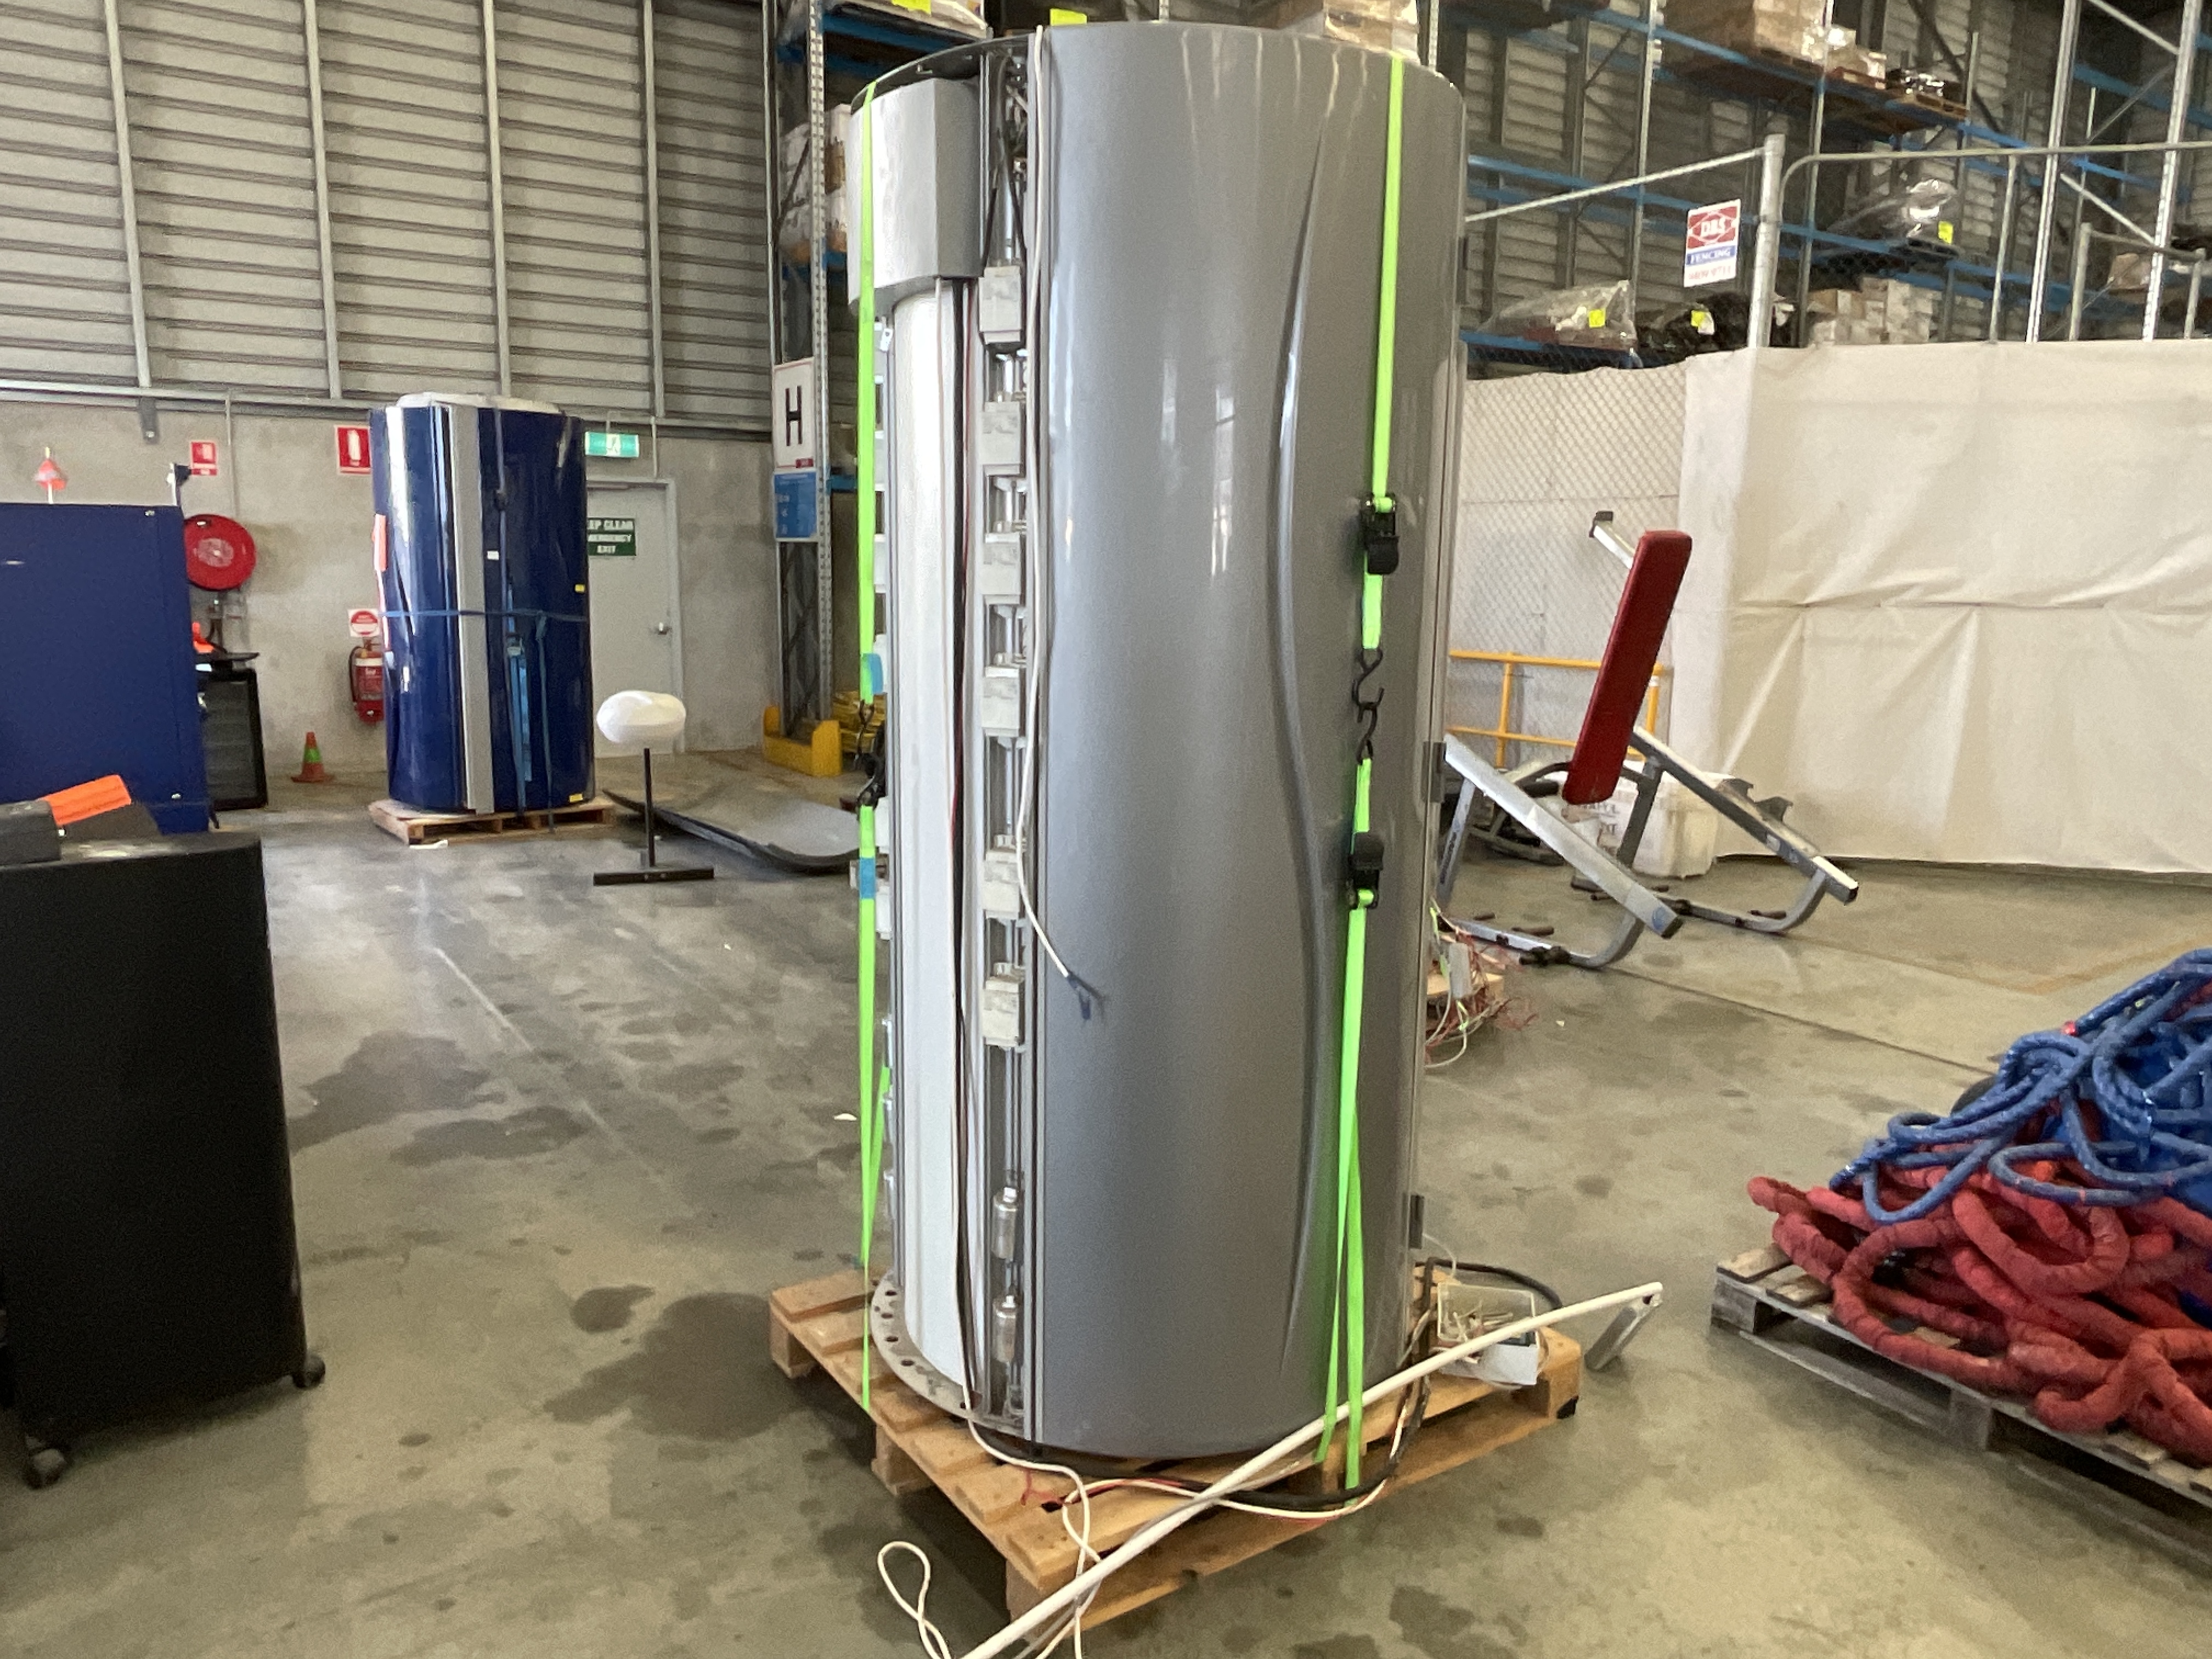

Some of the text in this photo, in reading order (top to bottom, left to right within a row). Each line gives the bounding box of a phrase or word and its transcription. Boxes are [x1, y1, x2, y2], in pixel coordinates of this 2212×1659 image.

[785, 386, 802, 447] H
[603, 520, 633, 531] CLEAR
[587, 534, 631, 543] MERGENCY
[596, 545, 616, 554] EXIT
